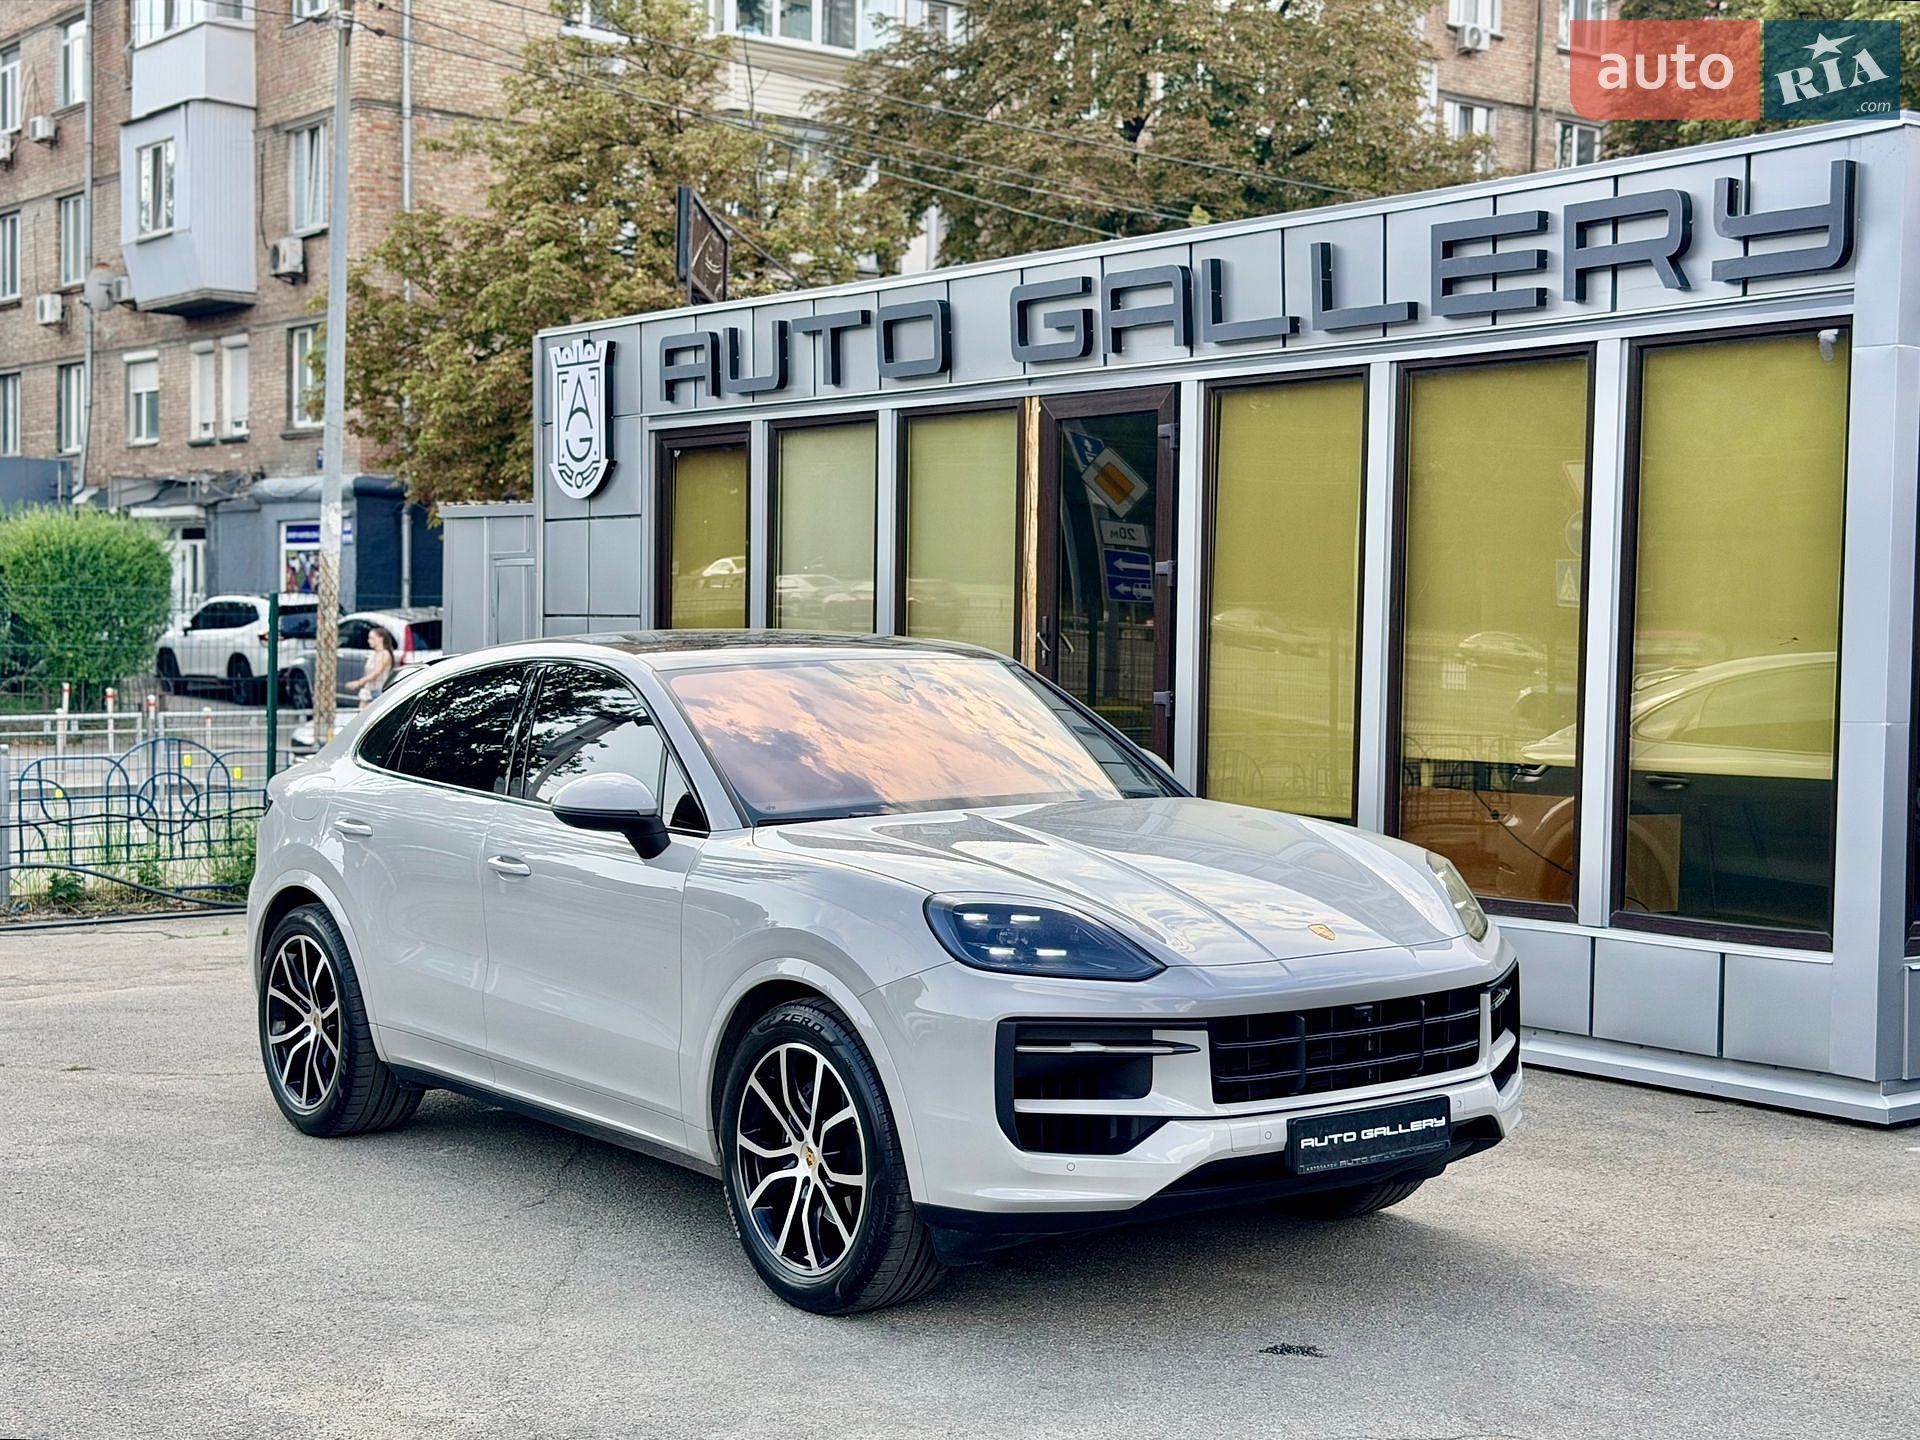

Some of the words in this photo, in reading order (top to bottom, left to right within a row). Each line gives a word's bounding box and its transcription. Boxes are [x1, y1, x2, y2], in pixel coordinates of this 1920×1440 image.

[659, 299, 952, 402] AUTO
[1010, 159, 1856, 362] GALLERY
[781, 1013, 825, 1033] ZERO
[1300, 1131, 1357, 1149] AUTO
[1361, 1116, 1446, 1140] GALLERY
